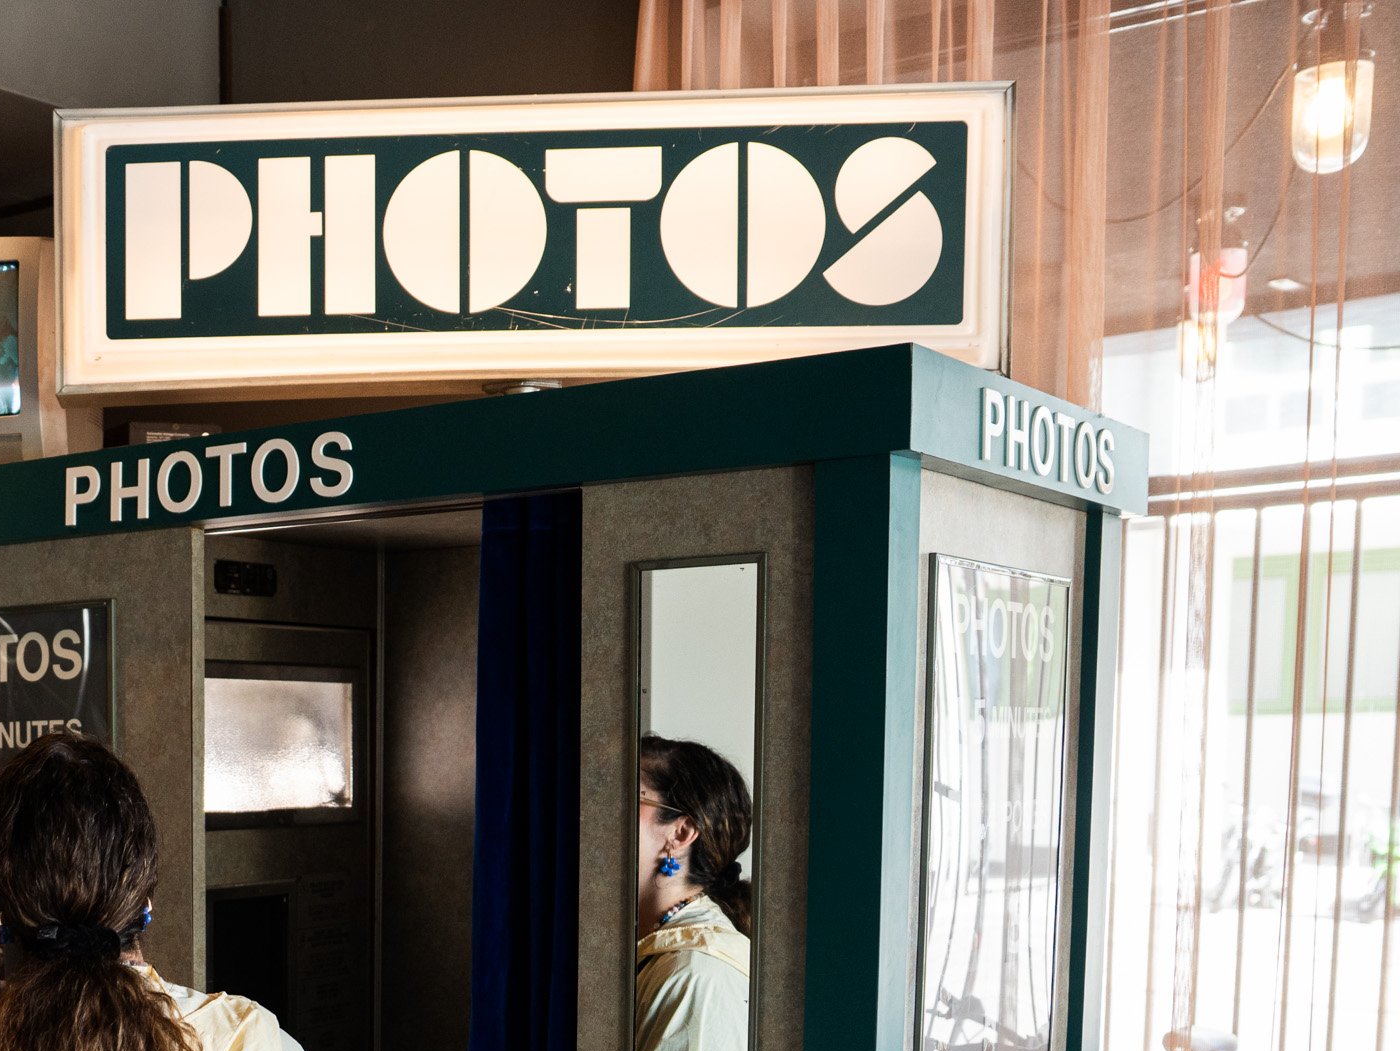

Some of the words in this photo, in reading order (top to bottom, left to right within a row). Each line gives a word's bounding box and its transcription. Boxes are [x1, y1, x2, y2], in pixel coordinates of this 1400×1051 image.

[125, 136, 943, 320] PHOTOS
[65, 431, 356, 526] PHOTOS
[981, 387, 1116, 494] PHOTOS
[953, 593, 1056, 663] PHOTOS
